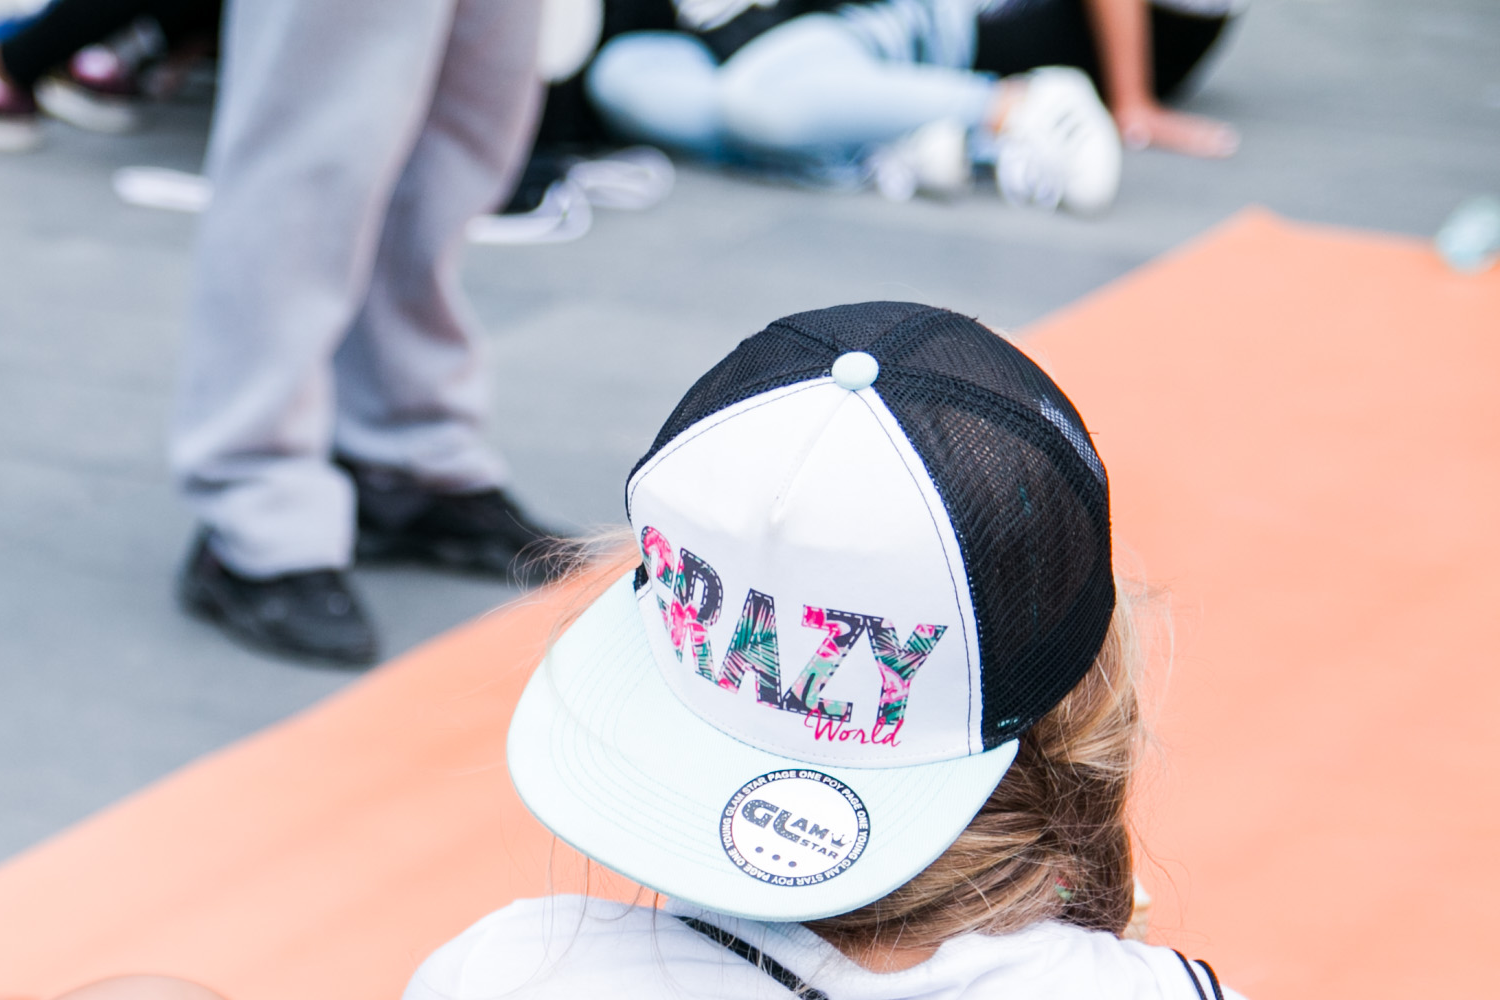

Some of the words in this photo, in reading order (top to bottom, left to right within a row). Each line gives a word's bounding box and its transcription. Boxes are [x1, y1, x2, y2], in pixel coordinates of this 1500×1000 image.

[641, 525, 949, 726] CRAZY
[804, 708, 904, 748] World
[741, 776, 768, 795] STAR
[767, 770, 797, 782] PAGE
[798, 770, 823, 782] ONE
[822, 776, 845, 790] POY
[725, 792, 745, 817] GLAM
[841, 788, 863, 811] PAGE
[856, 810, 869, 830] ONE
[722, 817, 734, 850] YOUNG
[799, 838, 839, 860] STAR
[848, 831, 869, 860] YOUNG
[727, 847, 746, 867] ONE
[742, 863, 771, 882] PAGE
[824, 859, 851, 879] GLAM
[770, 876, 794, 886] POY
[796, 874, 824, 886] STAR
